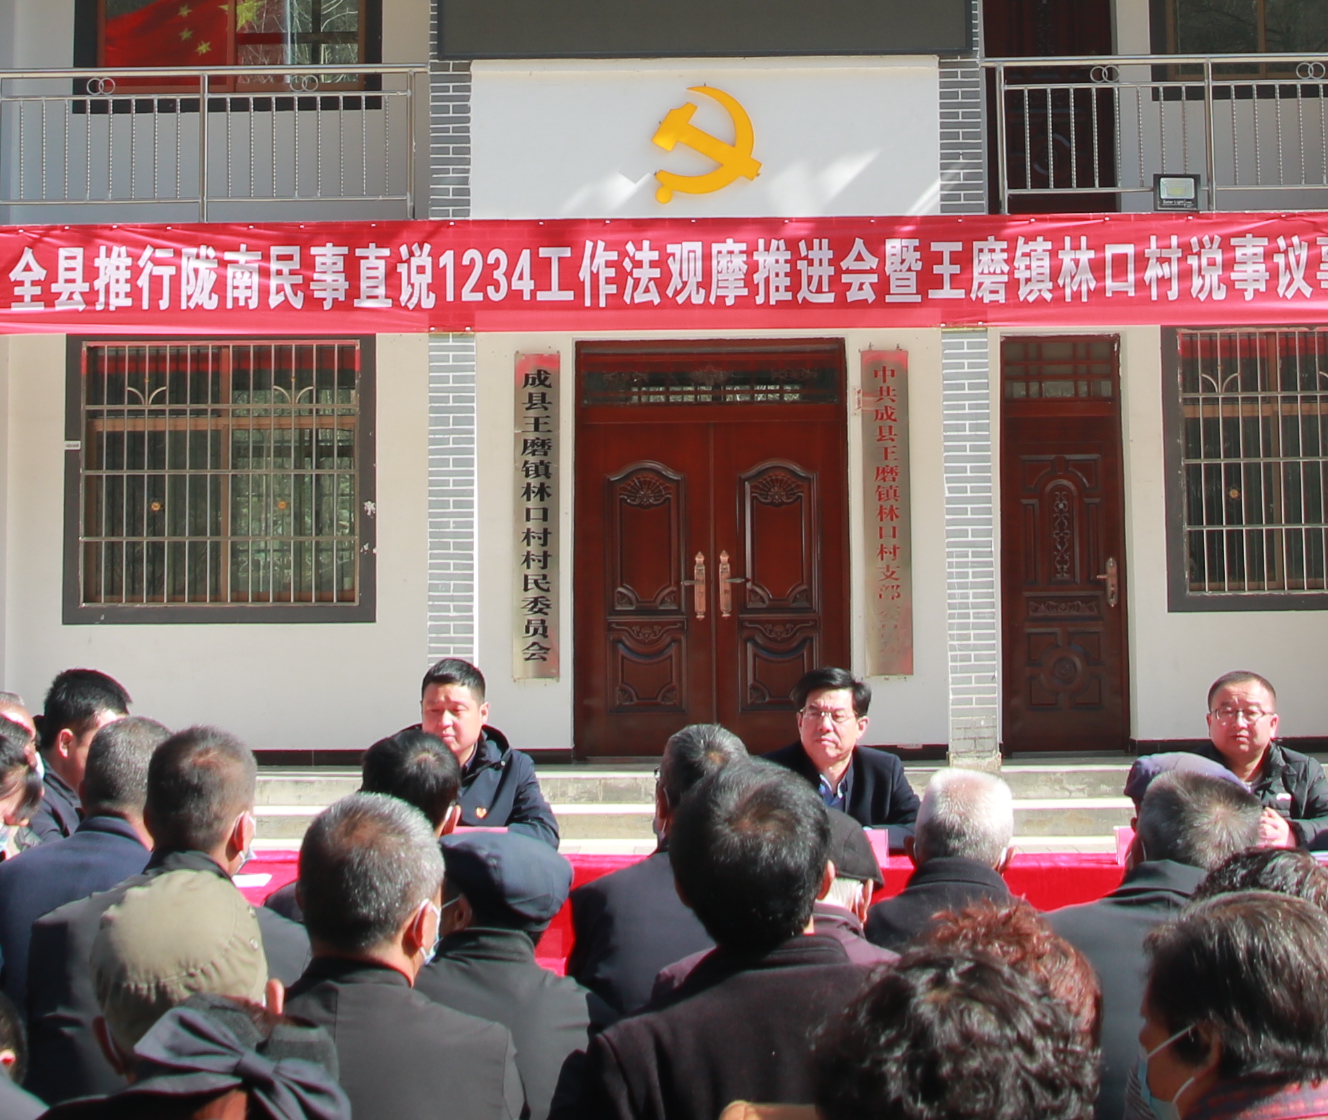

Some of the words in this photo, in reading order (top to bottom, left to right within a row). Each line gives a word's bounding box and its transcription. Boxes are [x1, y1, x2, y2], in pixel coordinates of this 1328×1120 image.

[521, 369, 552, 662] 成县王磨镇林口村村民委员会
[873, 365, 901, 655] 中共成县王磨镇林口村支部
